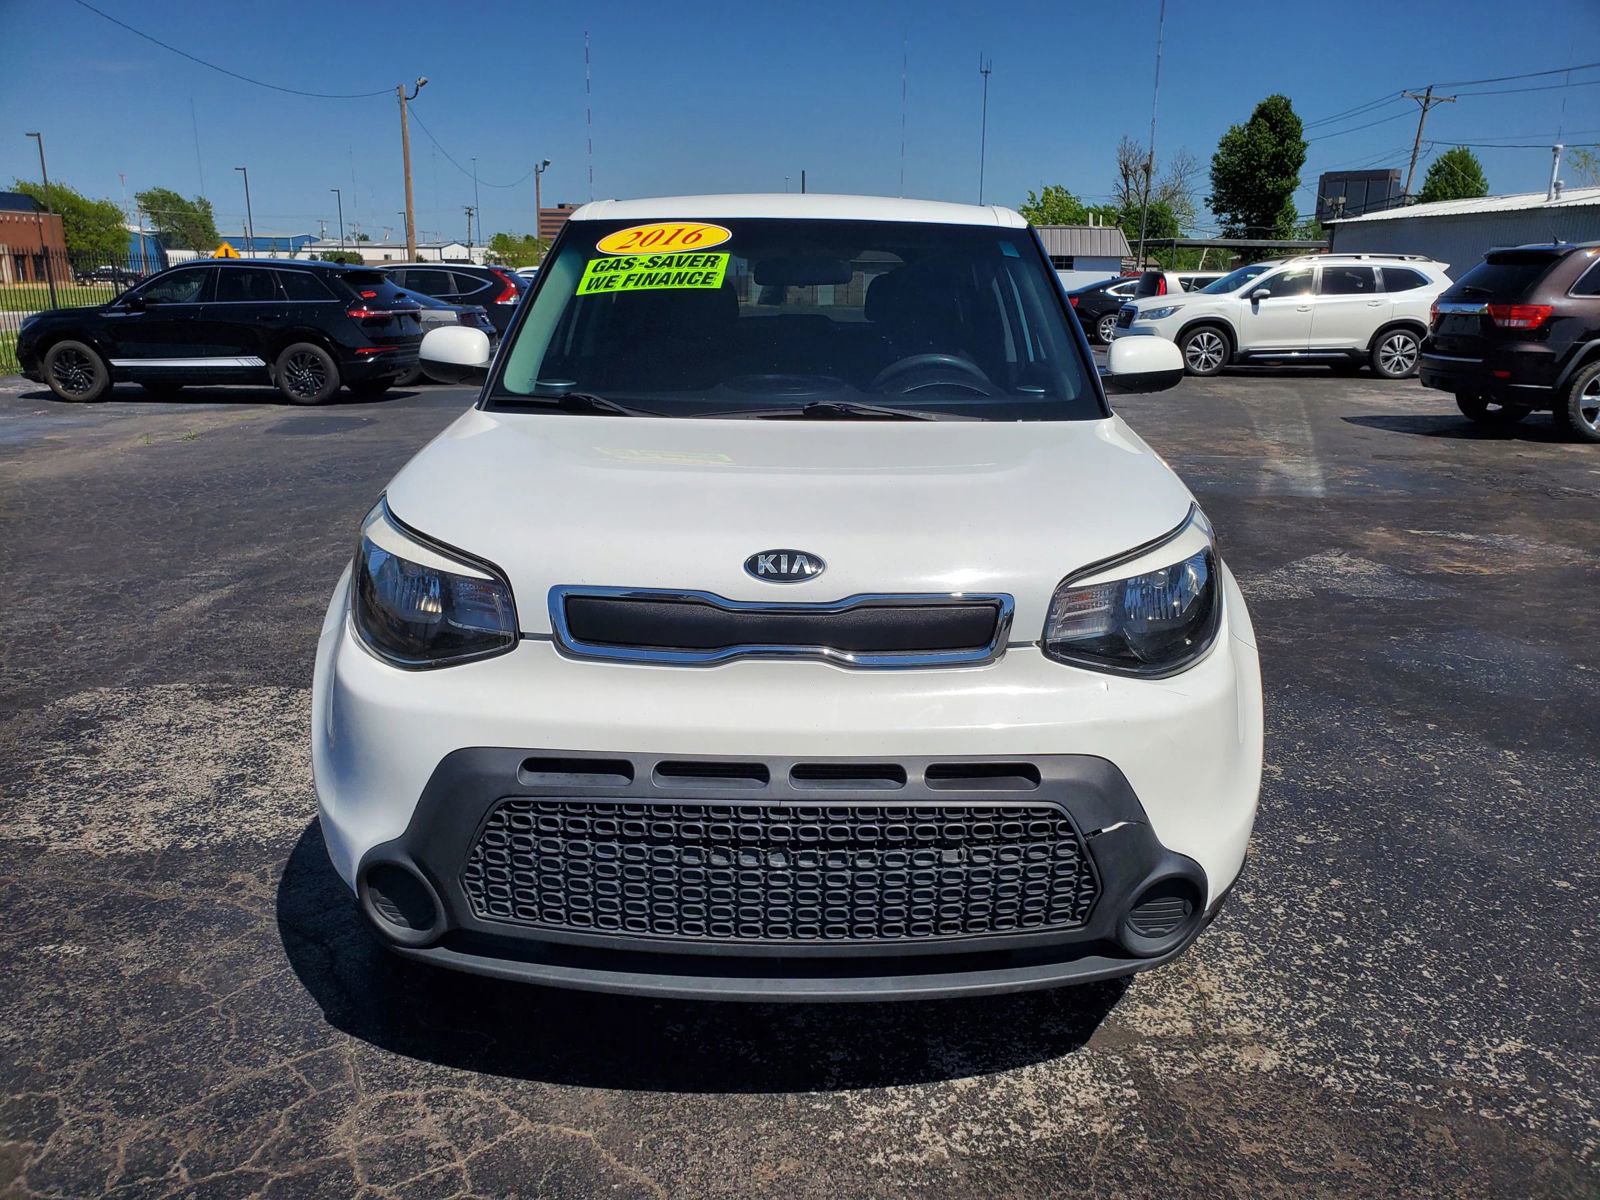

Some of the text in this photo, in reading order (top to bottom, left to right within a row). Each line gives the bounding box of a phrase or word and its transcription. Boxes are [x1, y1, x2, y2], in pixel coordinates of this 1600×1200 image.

[615, 226, 712, 250] 2016
[591, 255, 721, 274] GAS-SAVER
[585, 271, 718, 291] WE FINANCE
[757, 554, 812, 575] KIA
